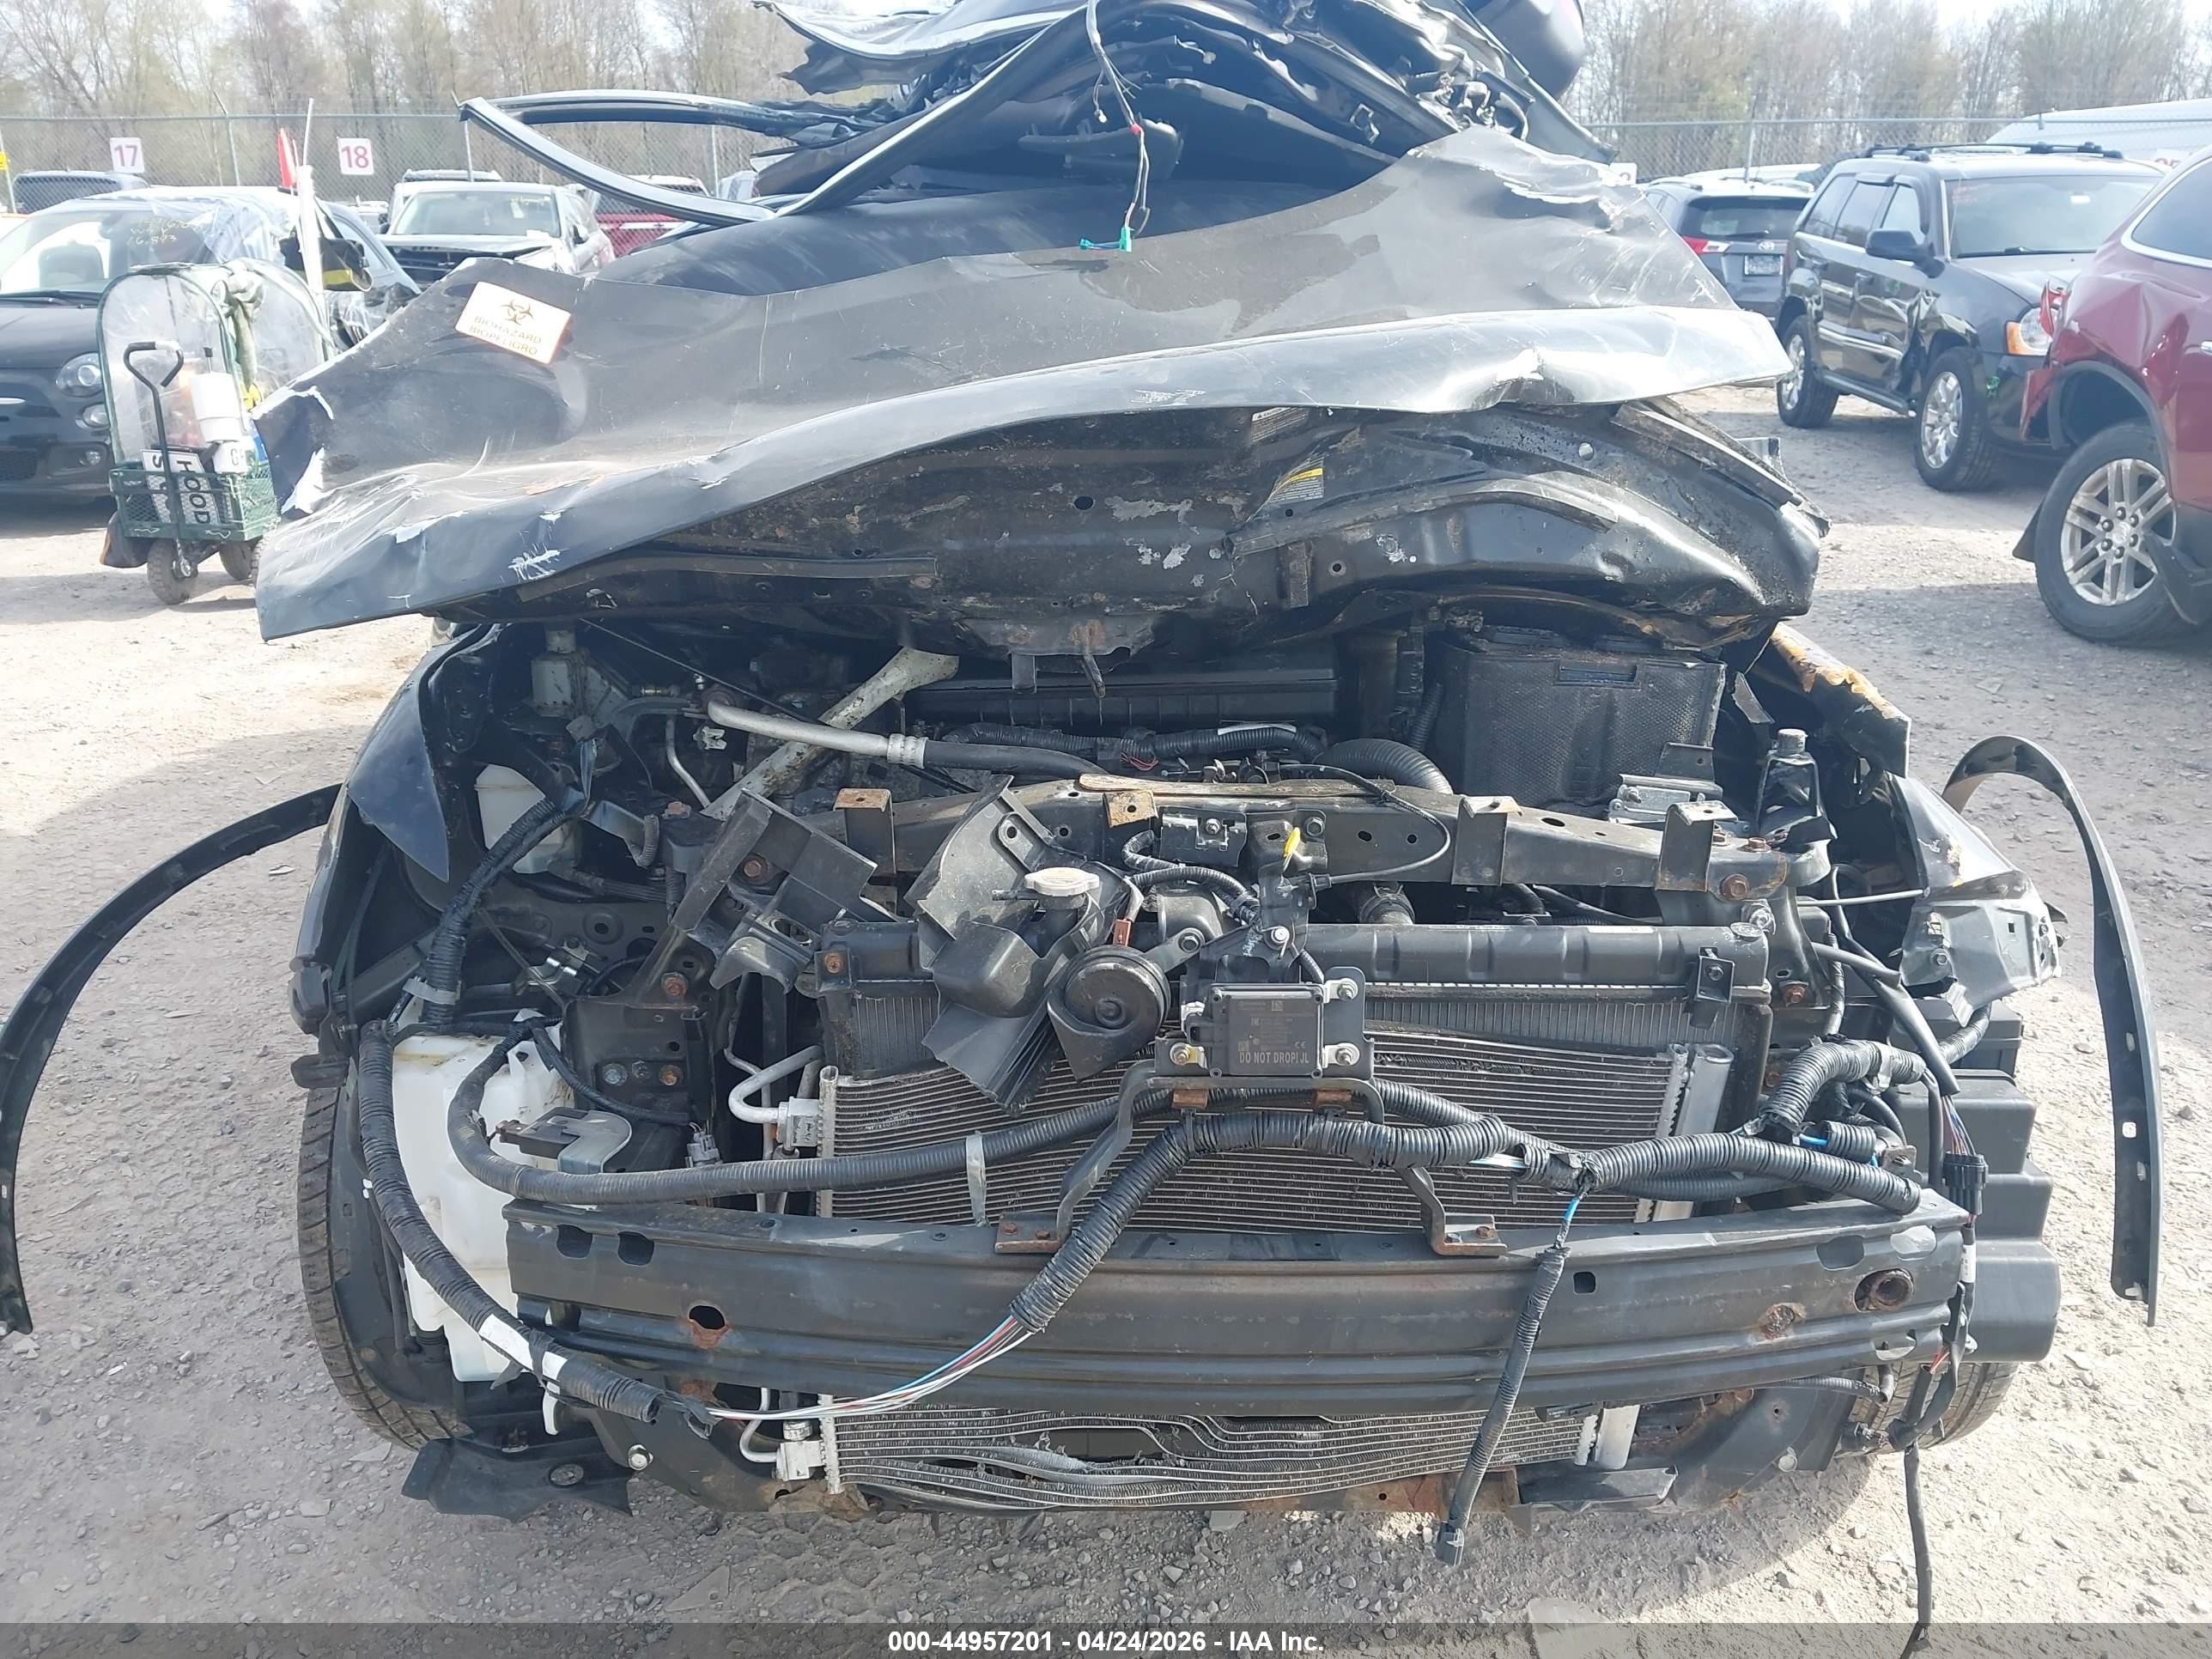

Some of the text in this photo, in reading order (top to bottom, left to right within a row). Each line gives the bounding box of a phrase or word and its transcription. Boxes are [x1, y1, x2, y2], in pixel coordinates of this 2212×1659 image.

[114, 144, 139, 167] 17
[341, 145, 370, 168] 18
[469, 325, 538, 356] BIOPELIGRO
[474, 315, 542, 344] BIOHAZARD
[176, 459, 210, 524] HOOD
[1239, 1052, 1251, 1064] DO
[1254, 1052, 1271, 1064] NOT
